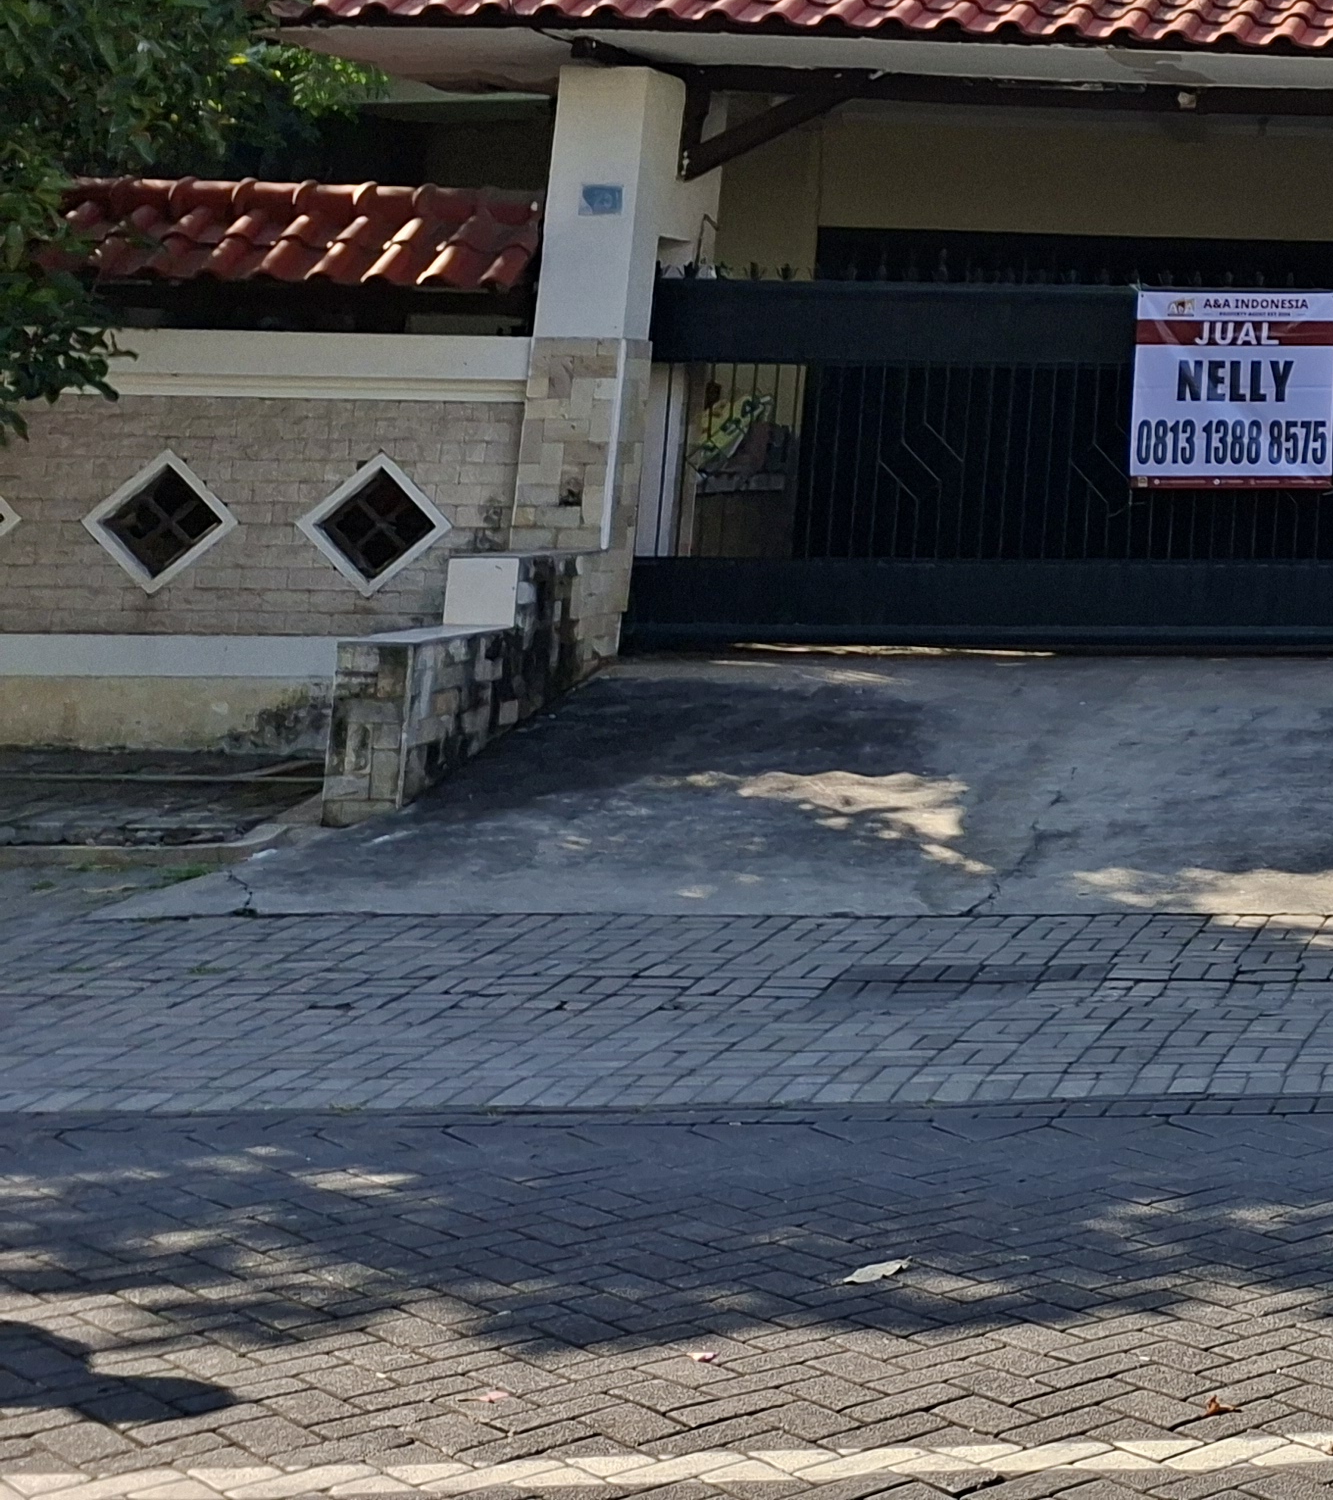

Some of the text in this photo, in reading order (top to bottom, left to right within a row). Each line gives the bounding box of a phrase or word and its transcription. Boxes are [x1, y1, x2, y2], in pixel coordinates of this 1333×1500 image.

[1203, 299, 1231, 309] A&A
[1235, 299, 1308, 309] INDONESIA
[1195, 321, 1280, 345] JUAL
[1176, 360, 1294, 402] NELLY
[1136, 419, 1327, 465] 0813 1388 8575
